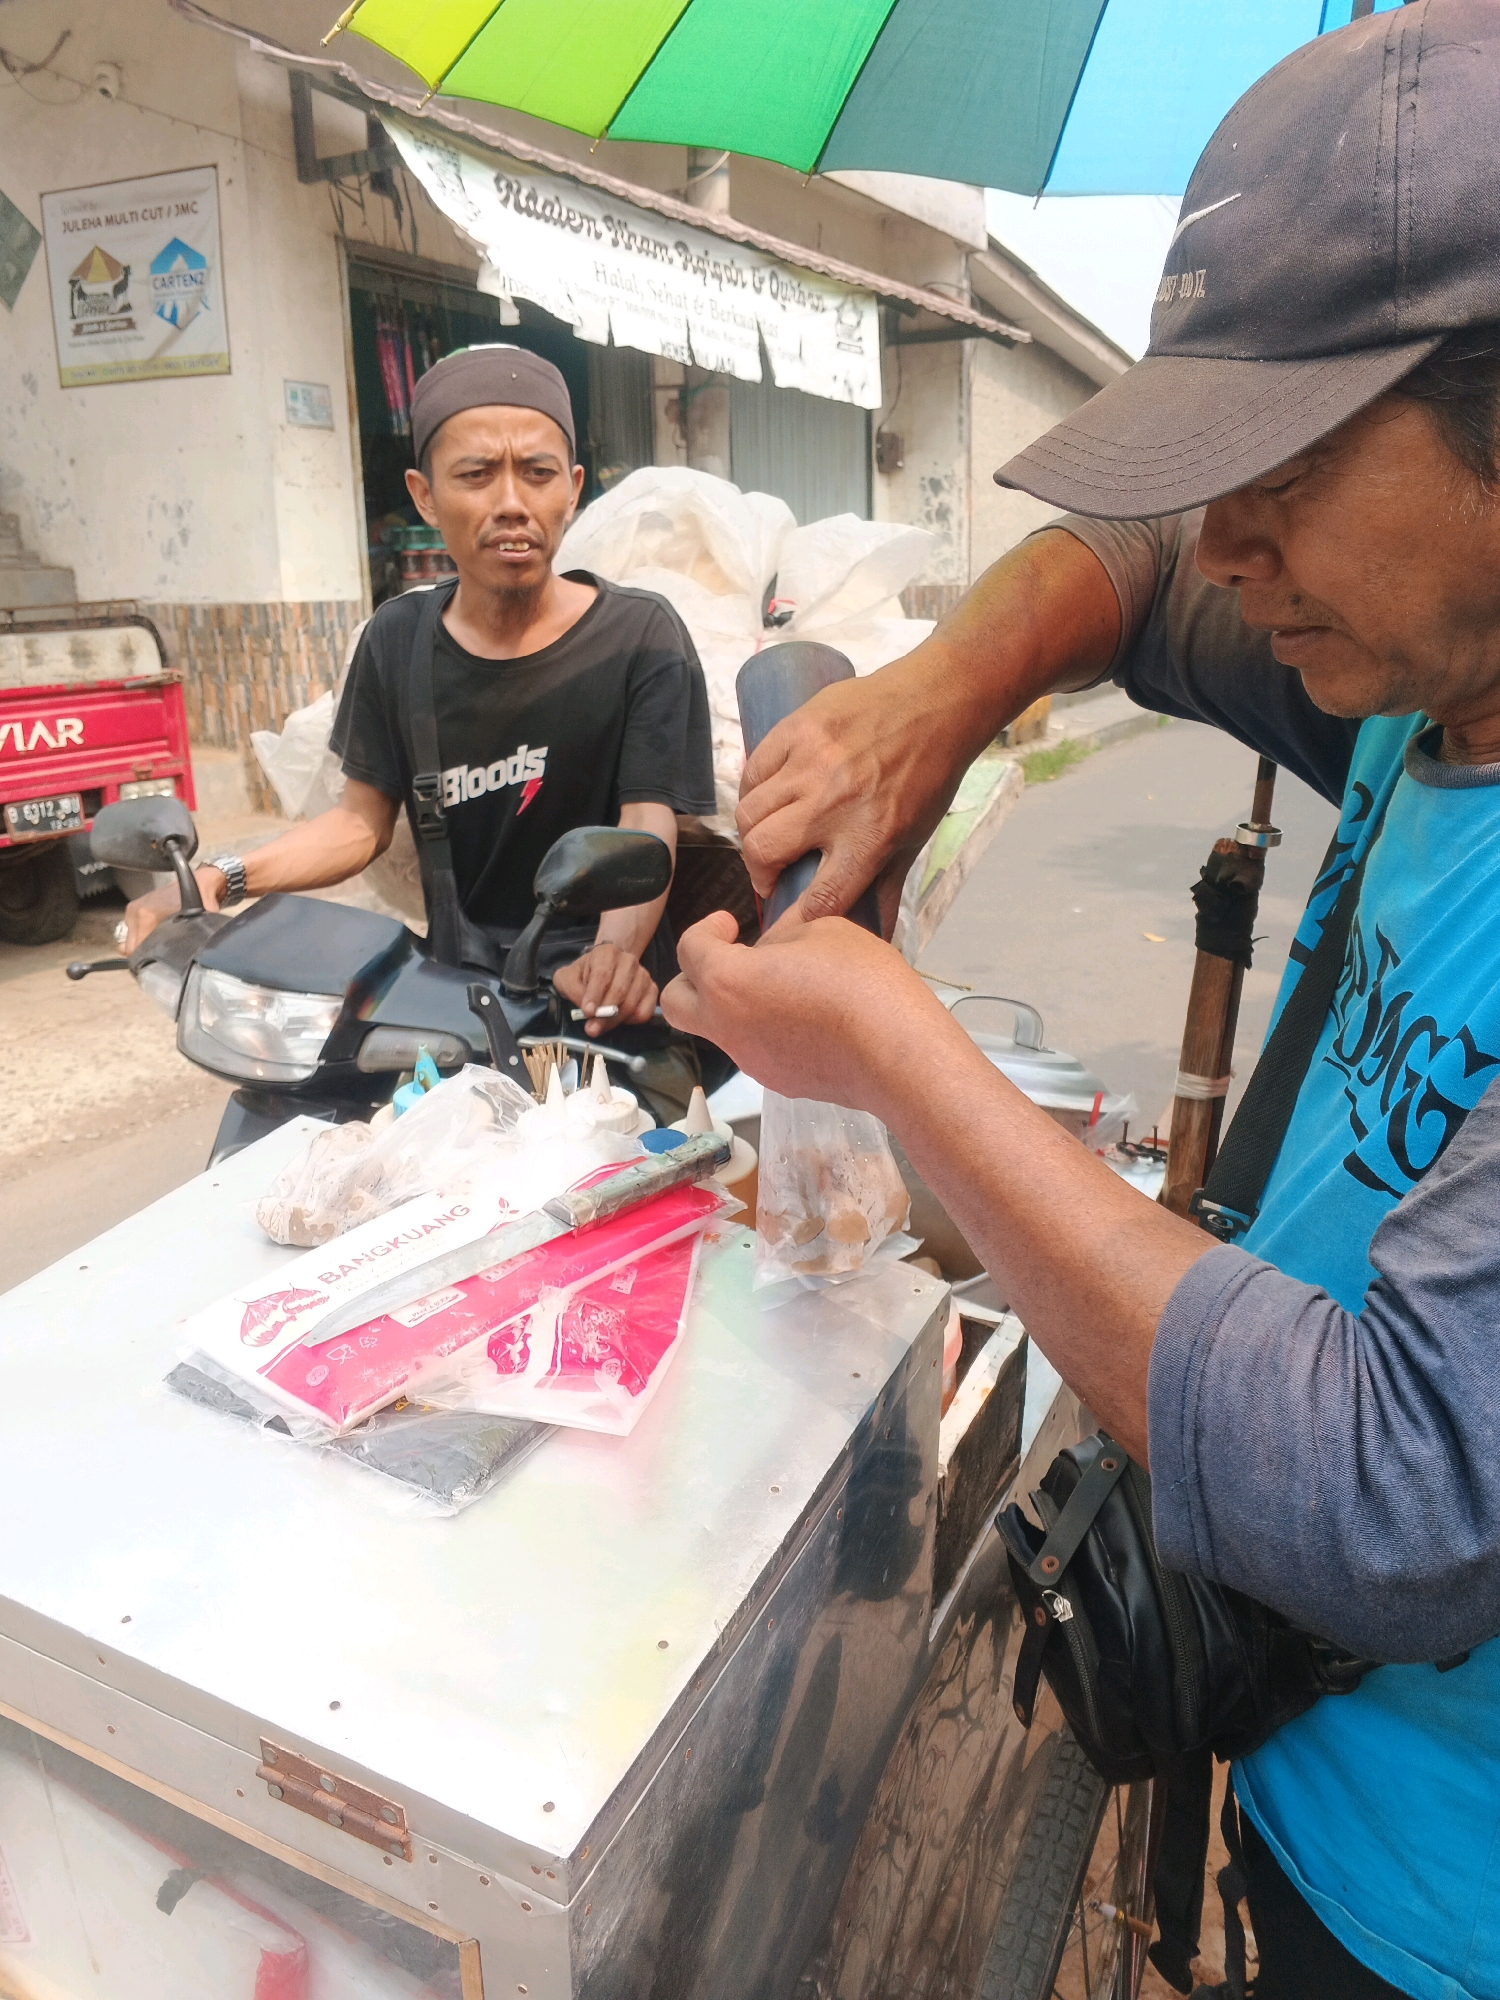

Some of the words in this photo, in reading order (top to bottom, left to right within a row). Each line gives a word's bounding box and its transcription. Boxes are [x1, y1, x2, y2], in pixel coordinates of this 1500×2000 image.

[104, 209, 140, 228] MULTI
[141, 207, 165, 223] CUT
[442, 744, 549, 808] Bloods
[317, 1204, 471, 1285] BANGKUANG
